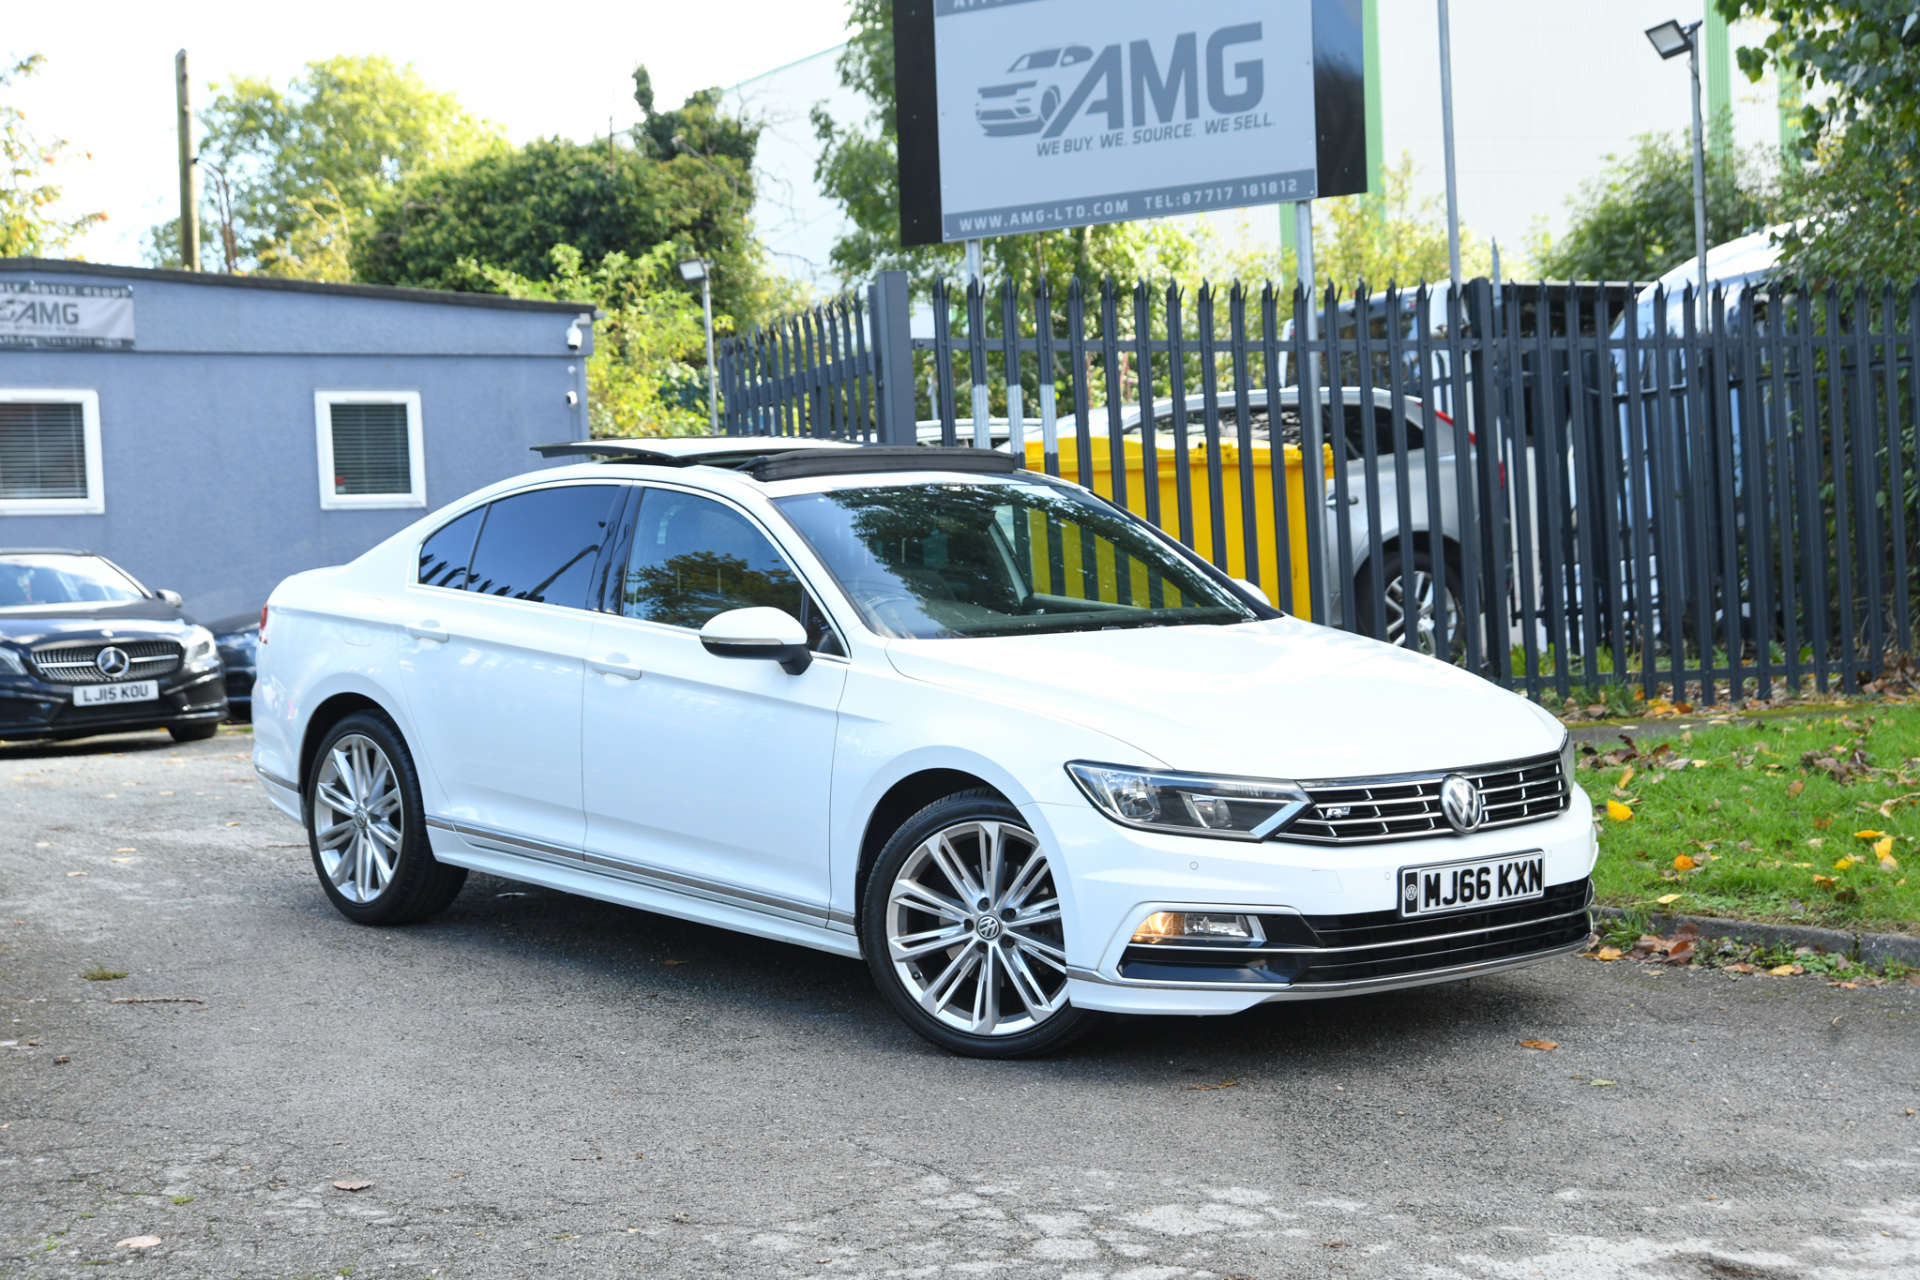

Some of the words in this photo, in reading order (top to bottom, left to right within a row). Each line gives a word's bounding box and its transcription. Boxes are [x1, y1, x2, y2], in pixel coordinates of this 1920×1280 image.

[1042, 21, 1265, 139] AMG
[1037, 140, 1060, 157] WE
[1205, 117, 1230, 136] WE
[958, 199, 1129, 233] WWW.AMG-LTD.COM
[15, 301, 80, 325] AMG
[1424, 866, 1491, 909] MJ66
[1498, 858, 1543, 898] KXN
